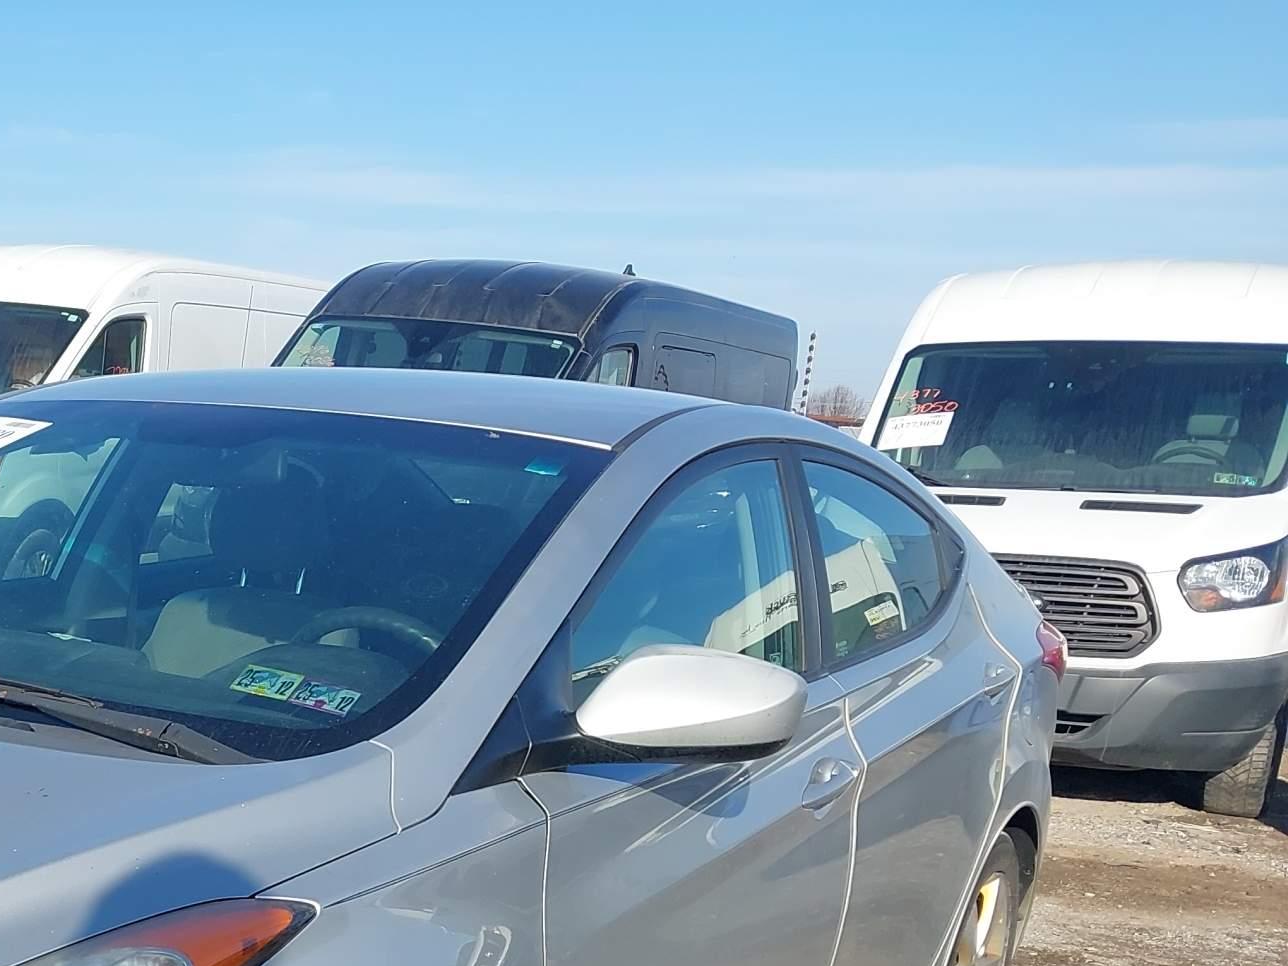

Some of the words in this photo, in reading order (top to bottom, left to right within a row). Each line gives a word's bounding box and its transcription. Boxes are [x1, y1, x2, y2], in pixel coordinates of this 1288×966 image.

[274, 680, 294, 696] 12
[295, 681, 319, 701] 25
[334, 695, 356, 712] 12
